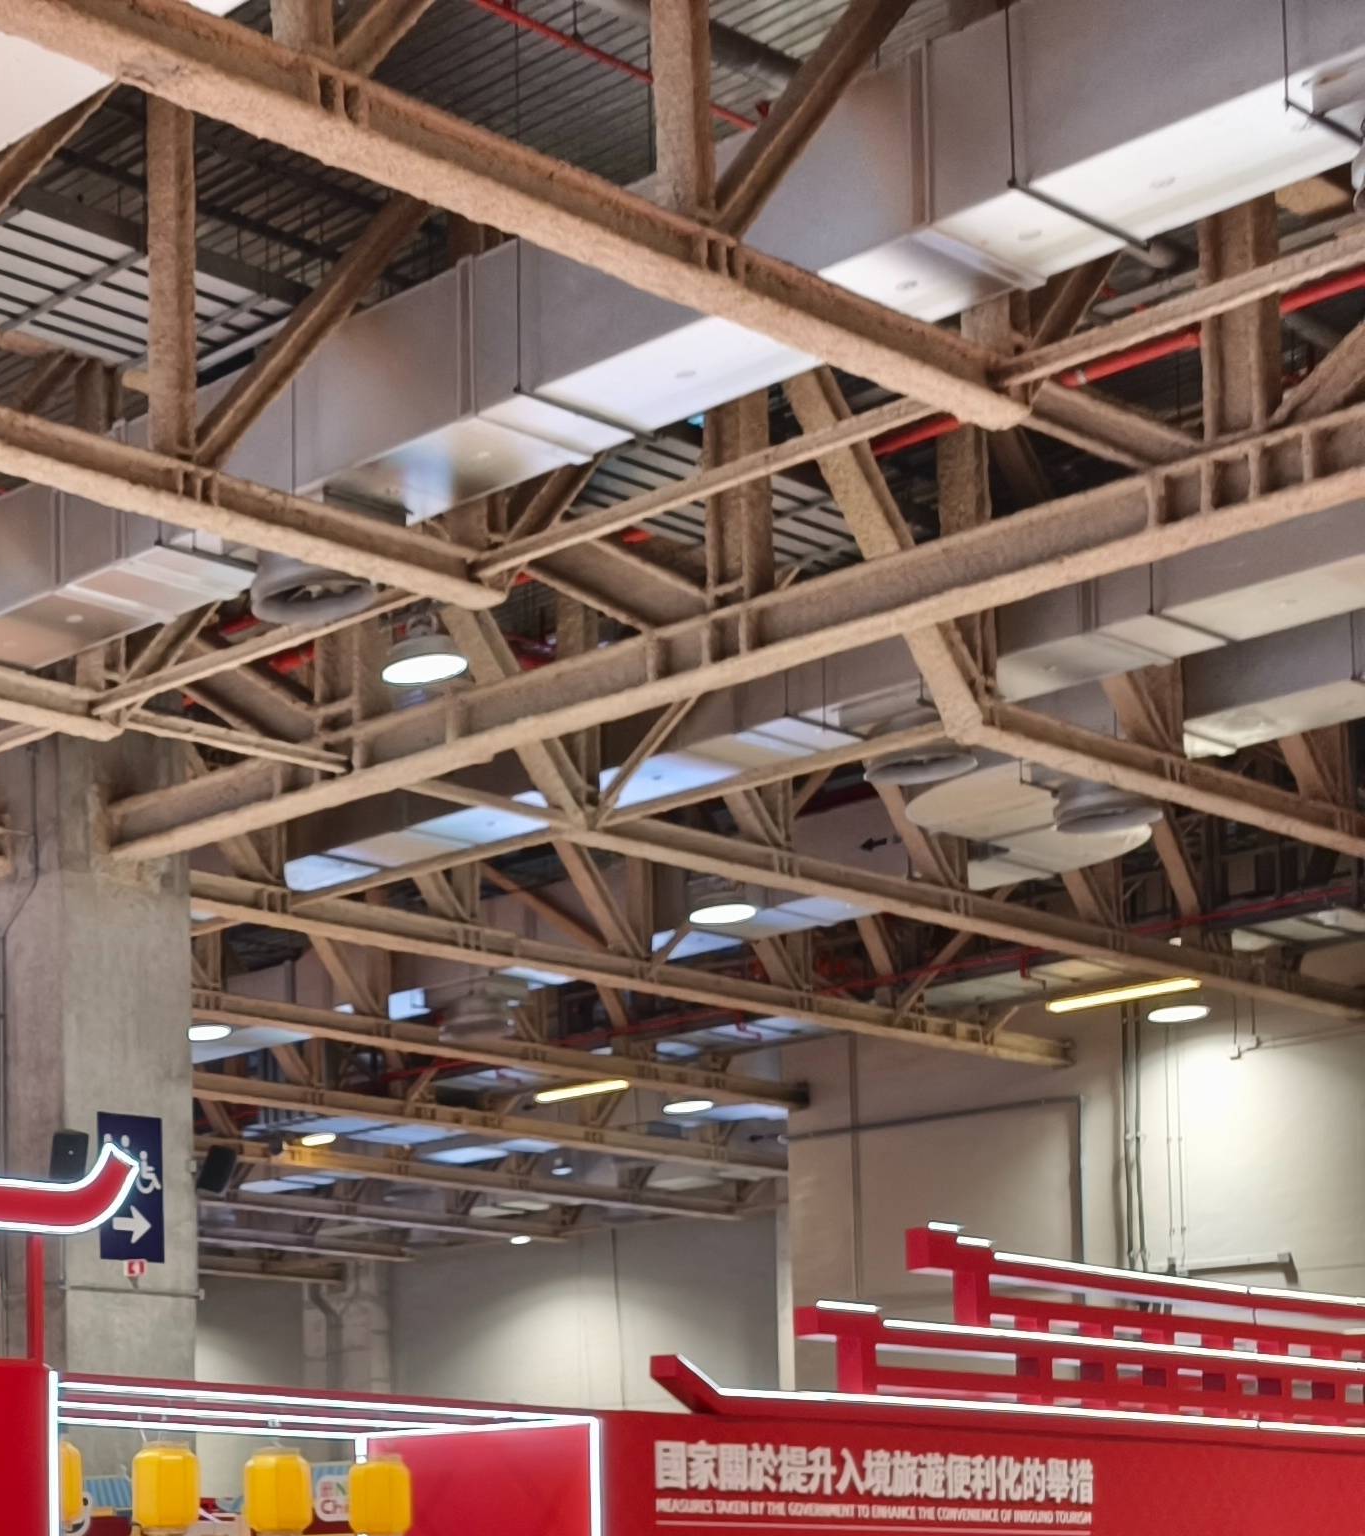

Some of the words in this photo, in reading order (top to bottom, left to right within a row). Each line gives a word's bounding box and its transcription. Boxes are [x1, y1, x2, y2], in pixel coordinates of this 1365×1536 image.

[655, 1498, 714, 1515] MEASURES
[716, 1501, 750, 1516] TAKEN
[751, 1502, 765, 1516] BY
[767, 1502, 786, 1517] THE
[788, 1502, 855, 1519] GOVERNMENT
[857, 1505, 870, 1519] TO
[871, 1505, 916, 1521] ENHANCE
[918, 1506, 935, 1521] THE
[937, 1507, 999, 1523] CONVENIENCE
[1000, 1509, 1013, 1523] OF
[1014, 1509, 1054, 1525] INBOUND
[1055, 1510, 1093, 1525] TOURISM
